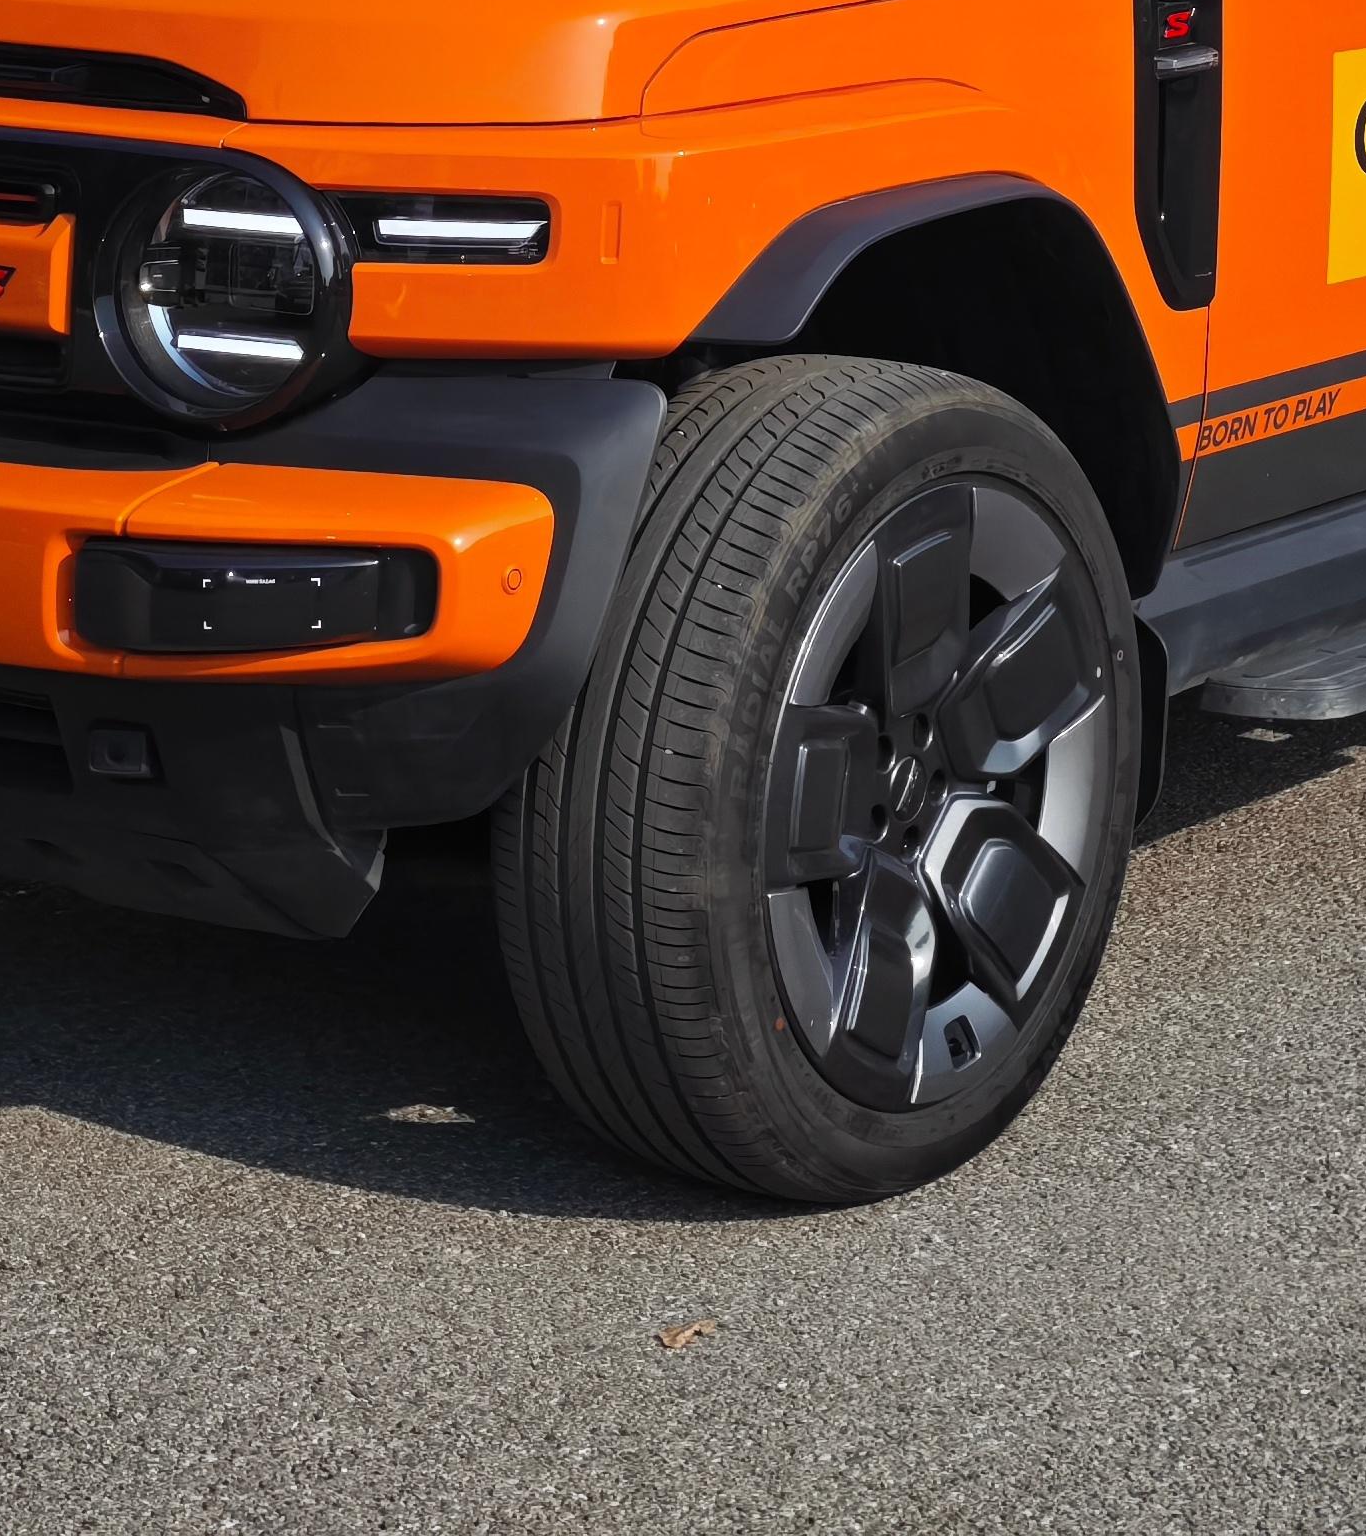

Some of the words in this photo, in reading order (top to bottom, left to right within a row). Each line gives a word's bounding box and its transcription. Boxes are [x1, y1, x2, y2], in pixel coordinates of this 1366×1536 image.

[1199, 411, 1259, 452] BORN
[1263, 403, 1290, 433] TO
[1292, 387, 1341, 424] PLAY
